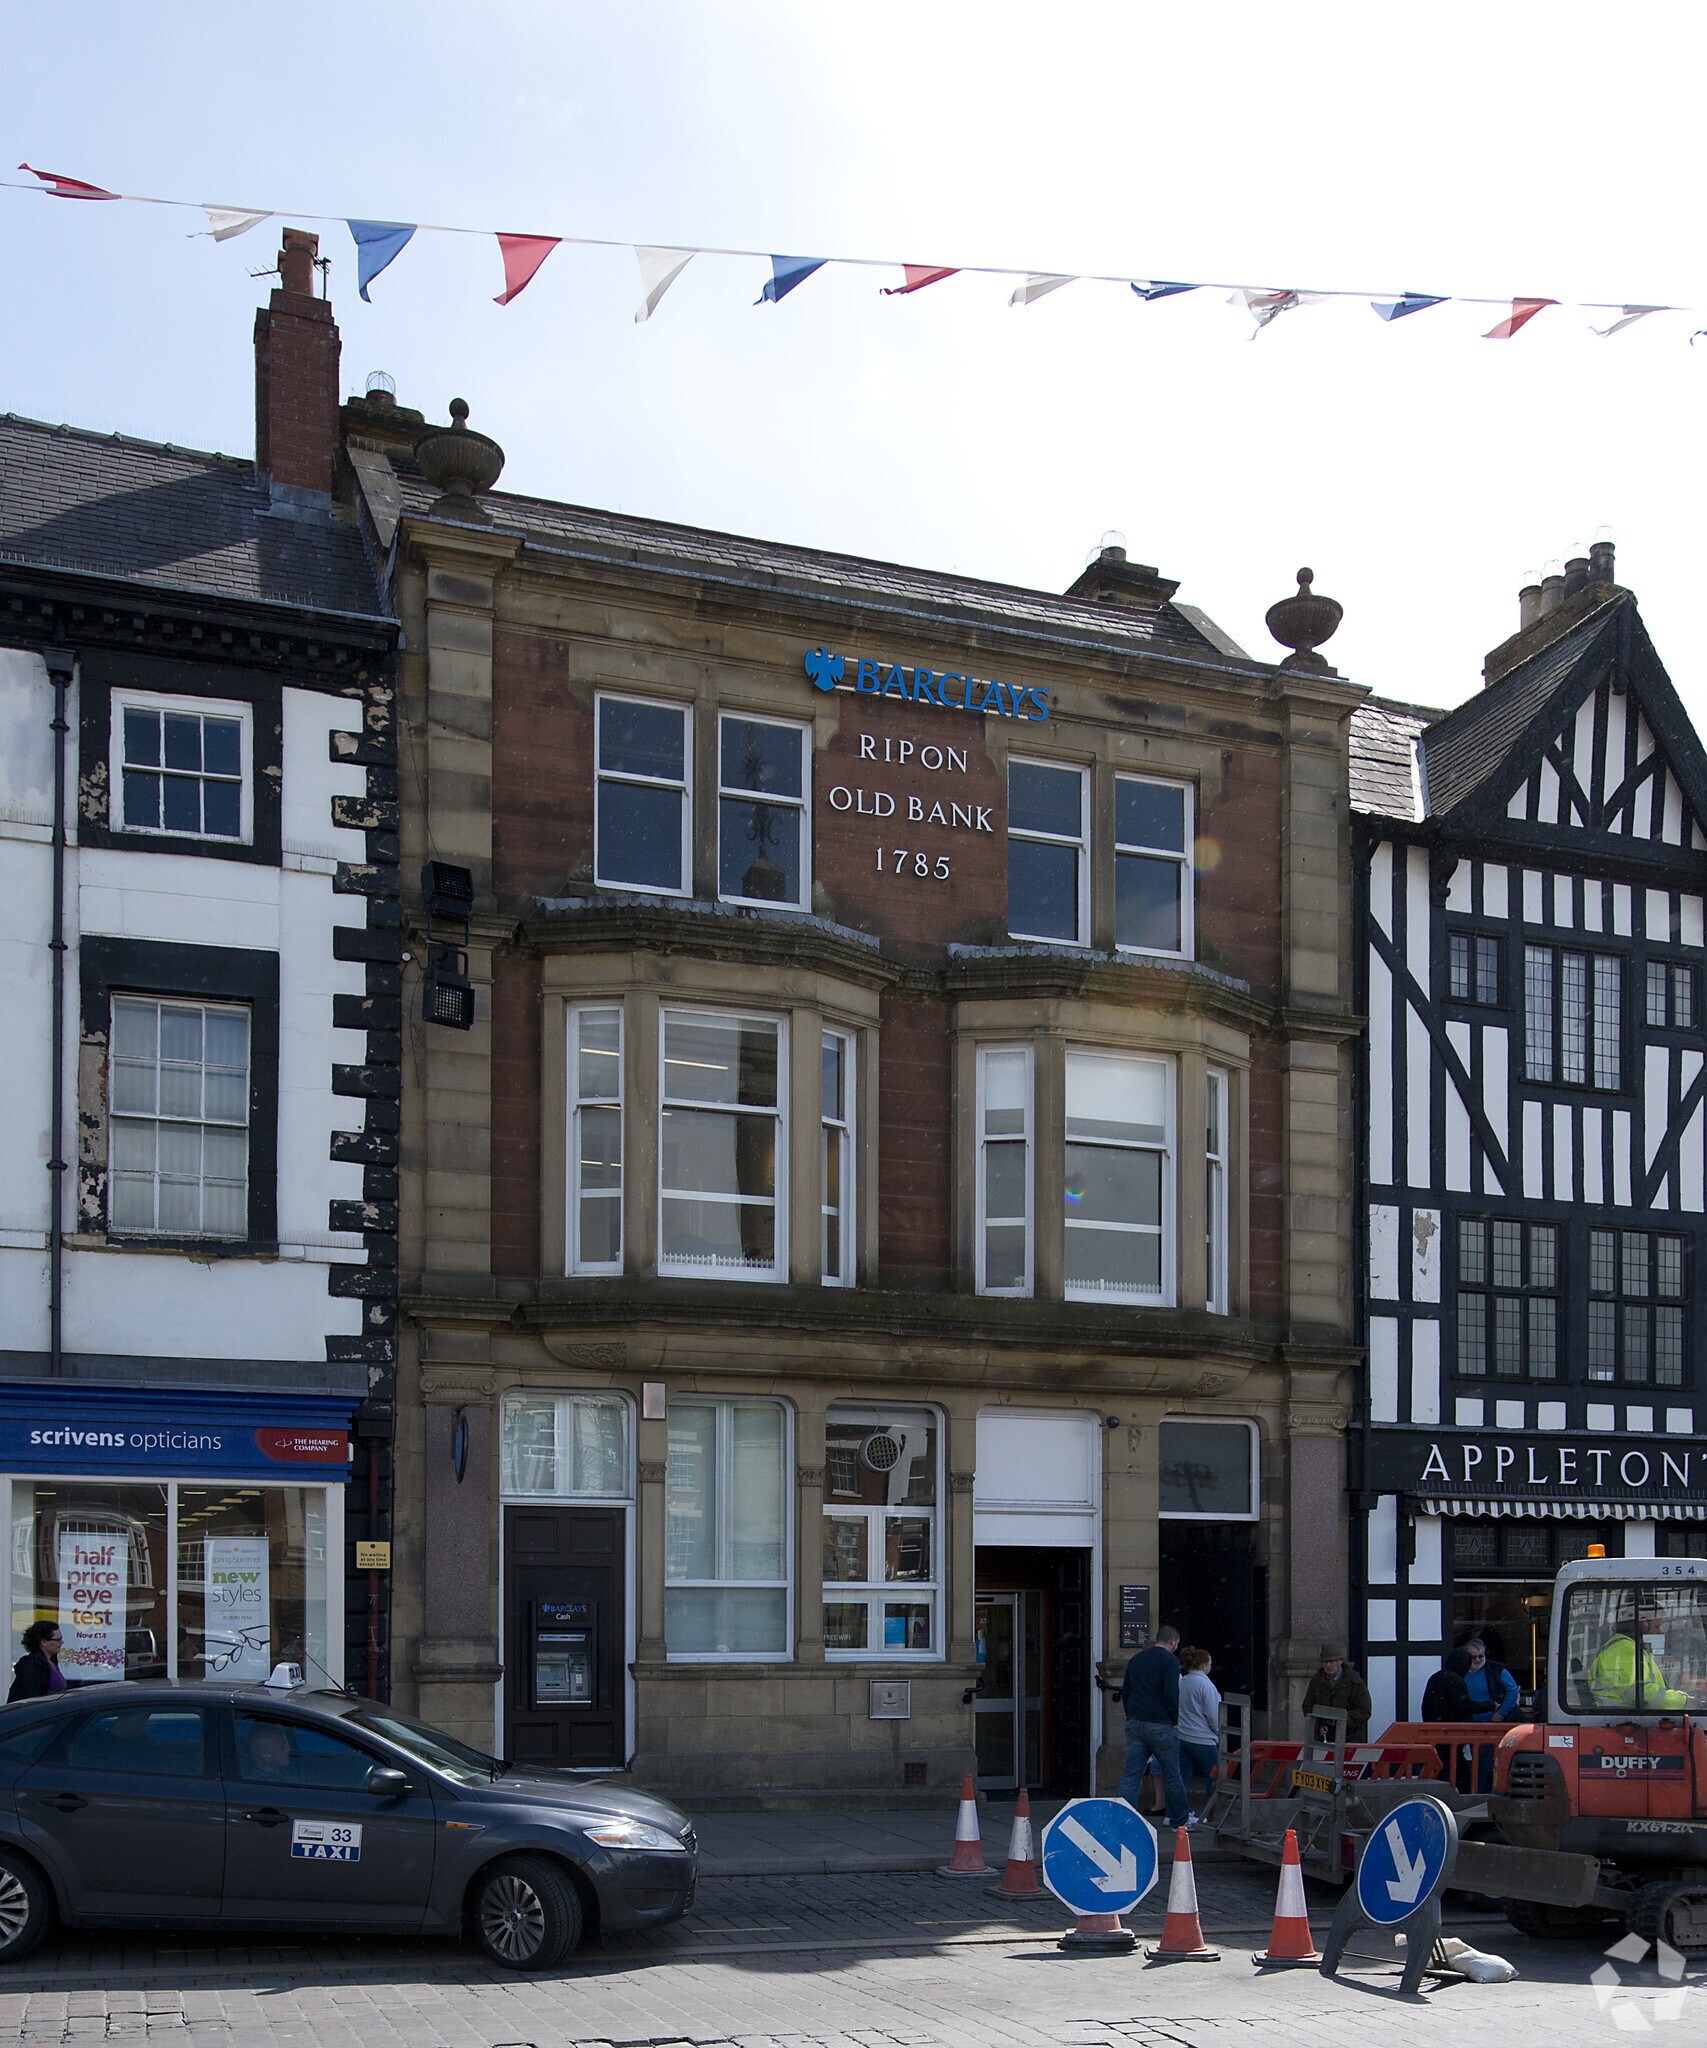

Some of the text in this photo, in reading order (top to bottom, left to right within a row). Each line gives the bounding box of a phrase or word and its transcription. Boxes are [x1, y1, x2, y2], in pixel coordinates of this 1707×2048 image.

[856, 658, 1049, 722] BARCLAYS
[859, 734, 968, 774] RIPON
[828, 785, 994, 832] OLD BANK
[876, 847, 950, 880] 1785
[30, 1427, 222, 1452] scrivens opticians
[74, 1545, 116, 1566] half
[67, 1567, 118, 1590] price
[212, 1572, 261, 1584] new
[1662, 1566, 1695, 1575] 354
[73, 1589, 112, 1608] eye
[212, 1584, 262, 1607] styles
[72, 1608, 112, 1625] test
[1601, 1756, 1661, 1769] DUFFY
[1296, 1771, 1314, 1787] FY03
[332, 1828, 352, 1842] 33
[302, 1844, 351, 1859] TAXI
